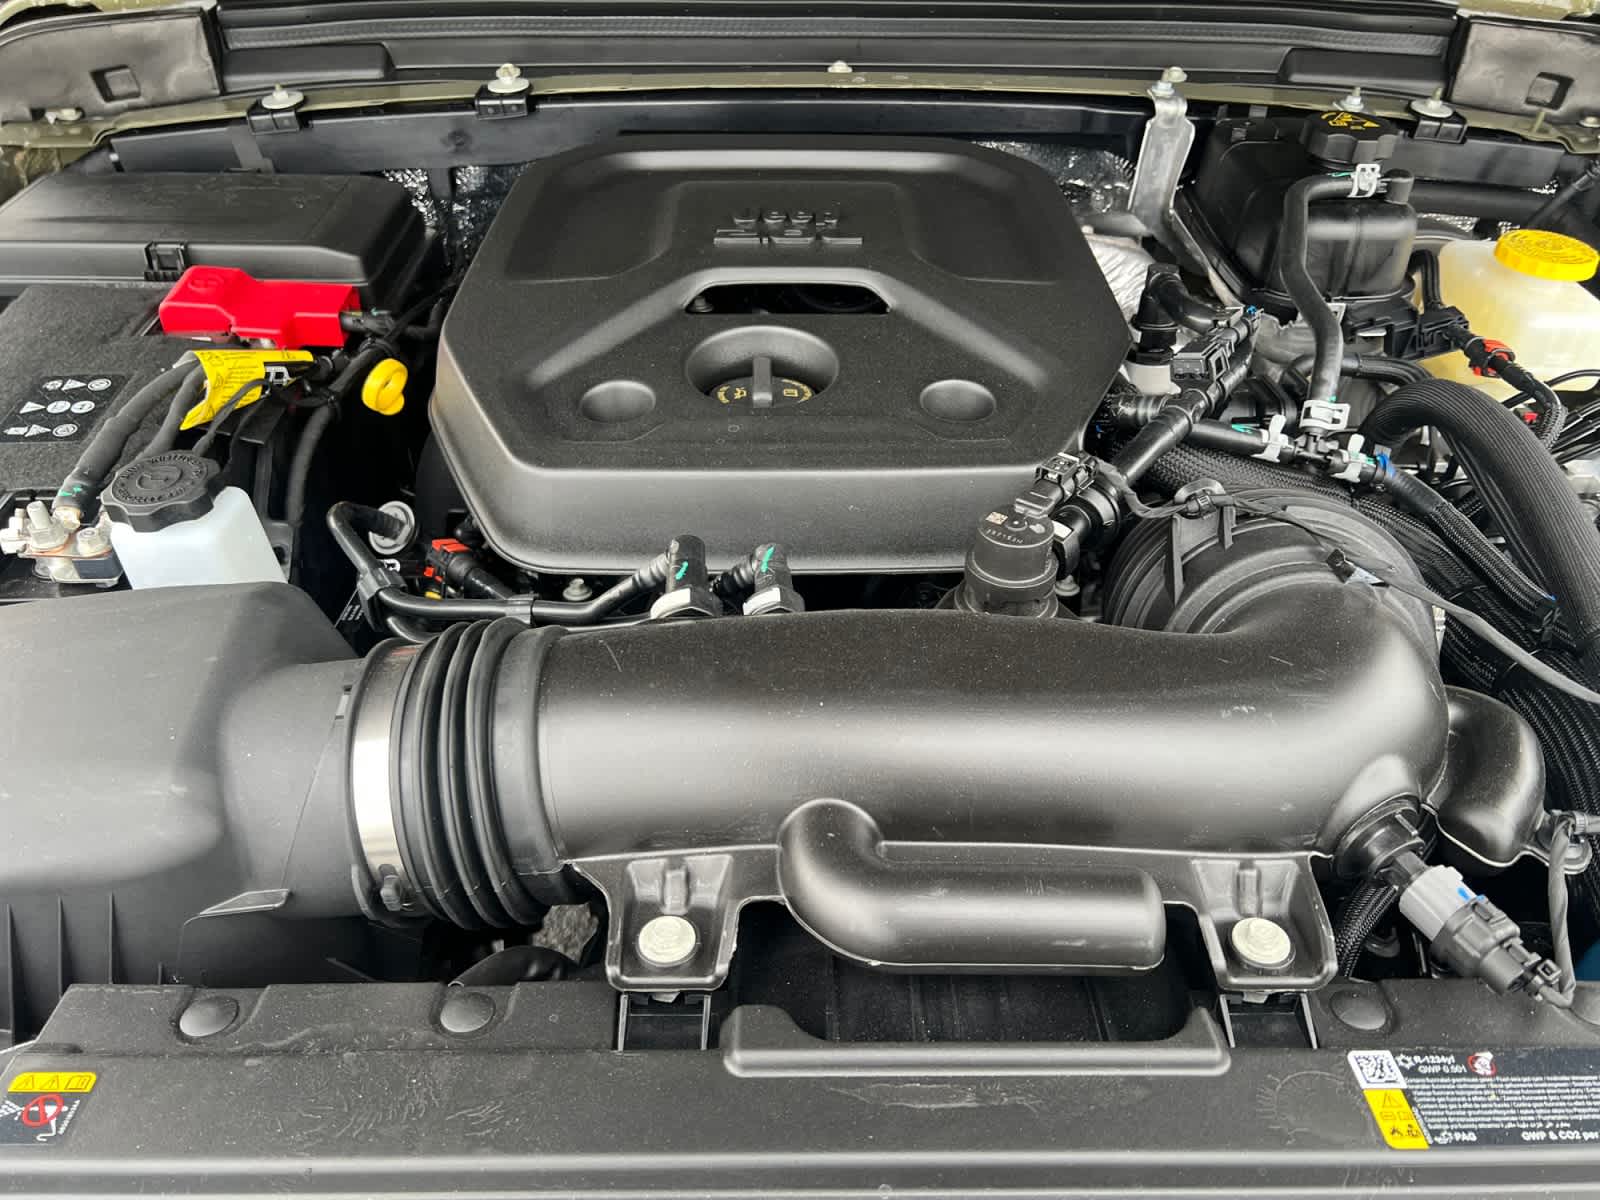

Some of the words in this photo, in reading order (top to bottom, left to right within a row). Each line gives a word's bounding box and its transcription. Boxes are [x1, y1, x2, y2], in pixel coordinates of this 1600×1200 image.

[1453, 1130, 1478, 1142] PAG
[1521, 1130, 1547, 1142] GWP
[1558, 1129, 1580, 1141] CO2
